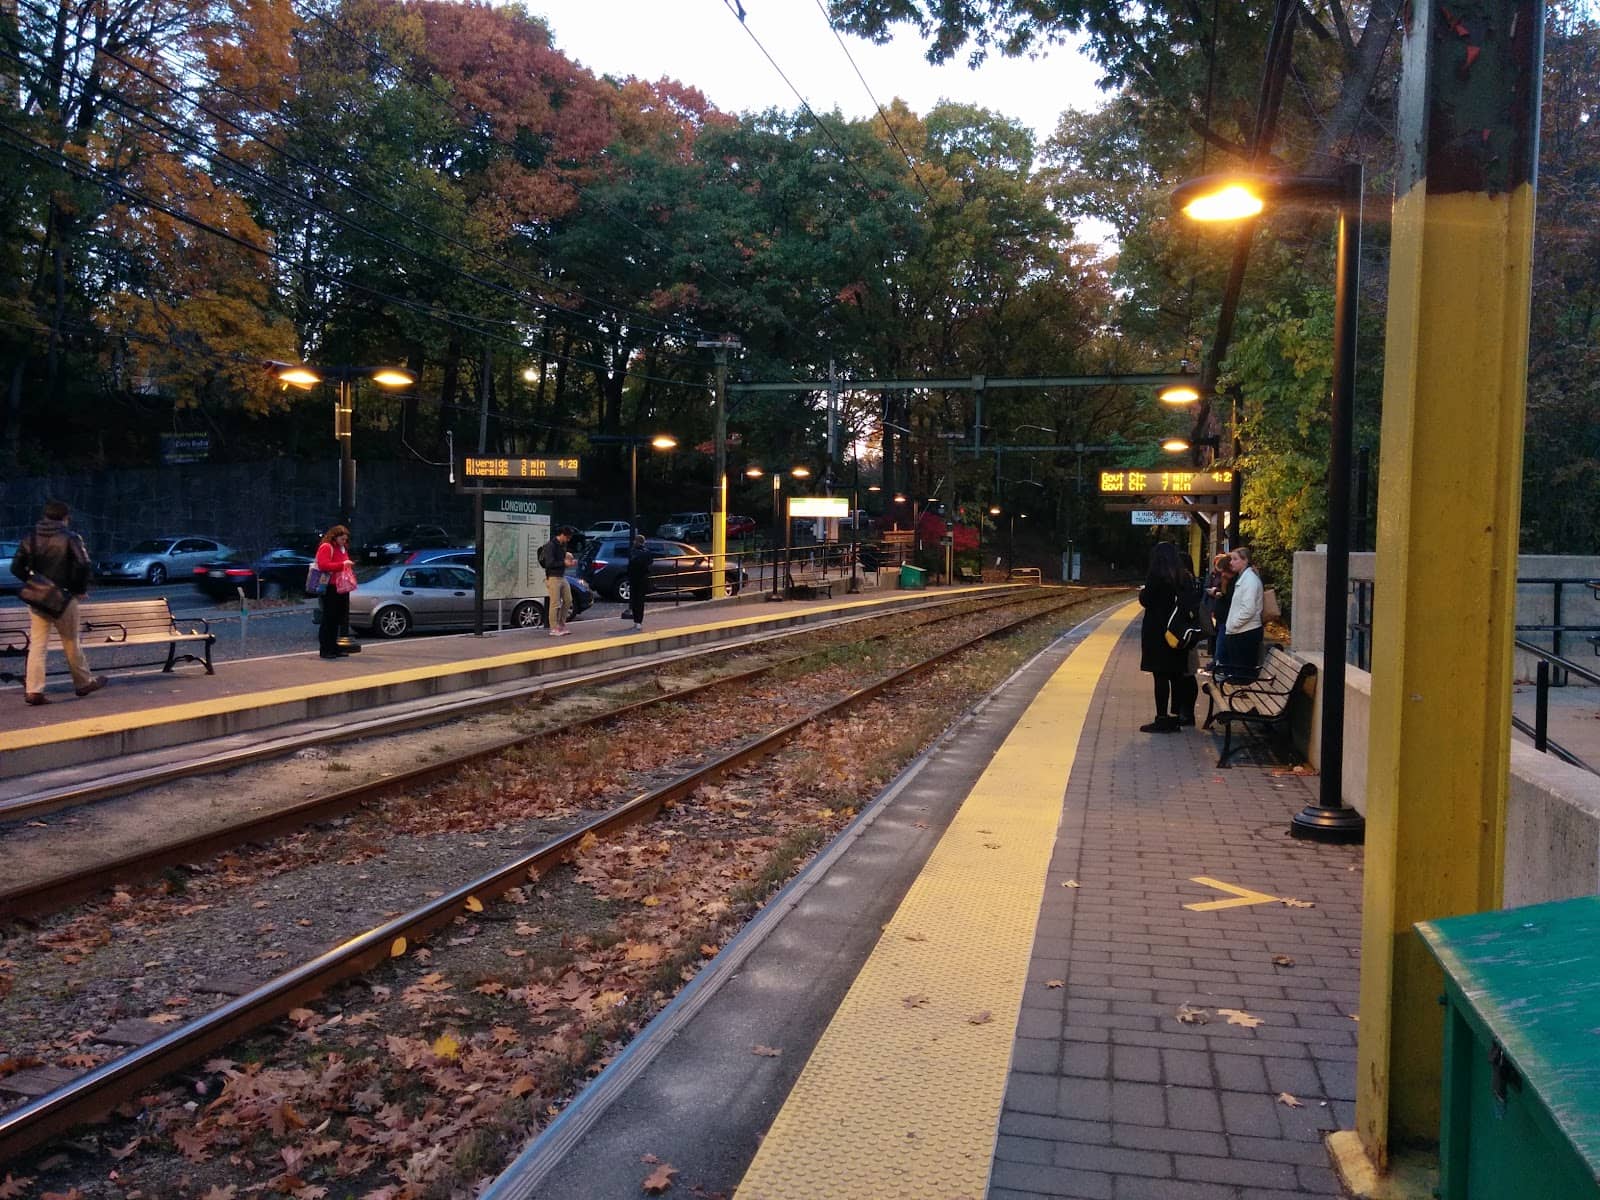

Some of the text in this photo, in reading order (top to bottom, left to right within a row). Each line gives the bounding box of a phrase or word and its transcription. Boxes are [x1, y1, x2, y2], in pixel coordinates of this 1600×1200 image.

[466, 459, 509, 468] Riverside
[531, 459, 546, 468] min
[558, 459, 577, 469] 4:29
[466, 467, 509, 476] Riverside
[531, 468, 546, 476] min
[1129, 473, 1146, 482] Ctr
[1173, 473, 1191, 482] min
[1129, 482, 1146, 491] Ctr
[1162, 481, 1168, 491] 7
[1173, 482, 1191, 491] min
[501, 499, 537, 513] LONGWOOD
